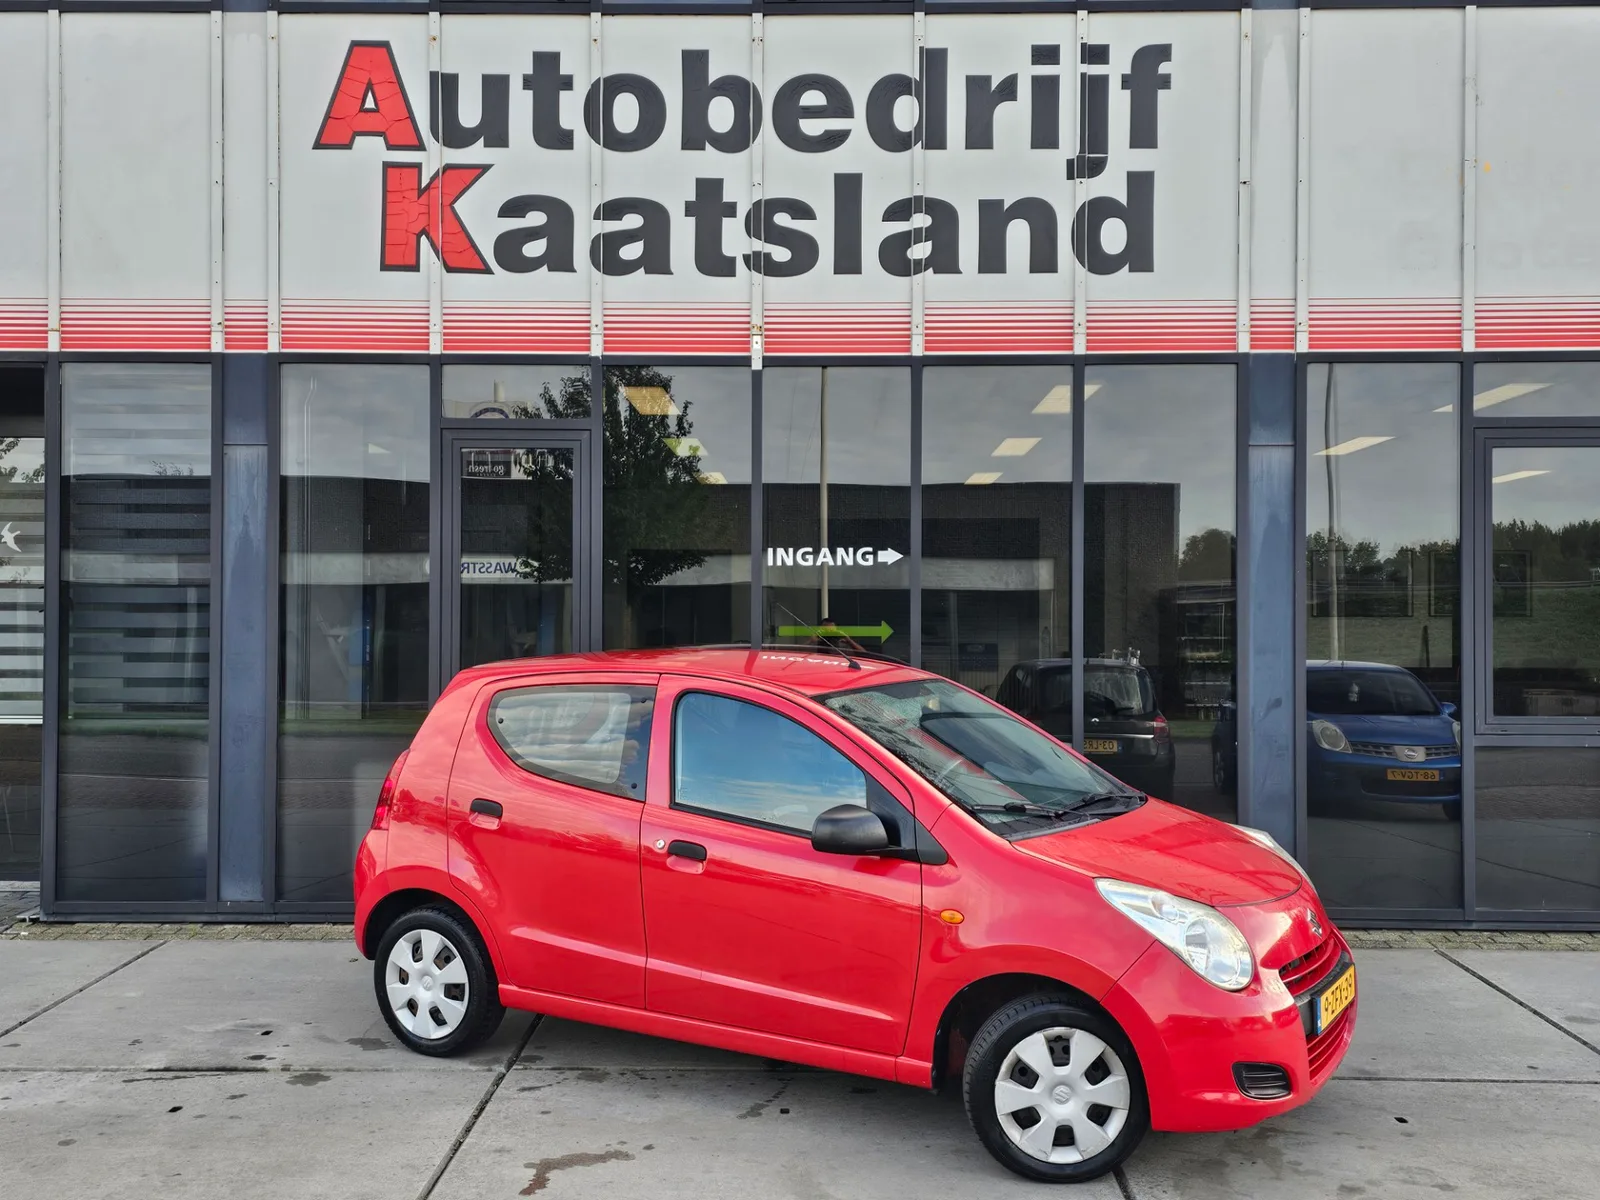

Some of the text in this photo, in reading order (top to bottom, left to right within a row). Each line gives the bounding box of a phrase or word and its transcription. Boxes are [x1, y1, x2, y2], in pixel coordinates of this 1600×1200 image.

[312, 40, 1172, 181] Autobedrijf
[380, 161, 1155, 278] Kaatsland
[767, 547, 874, 566] INGANG
